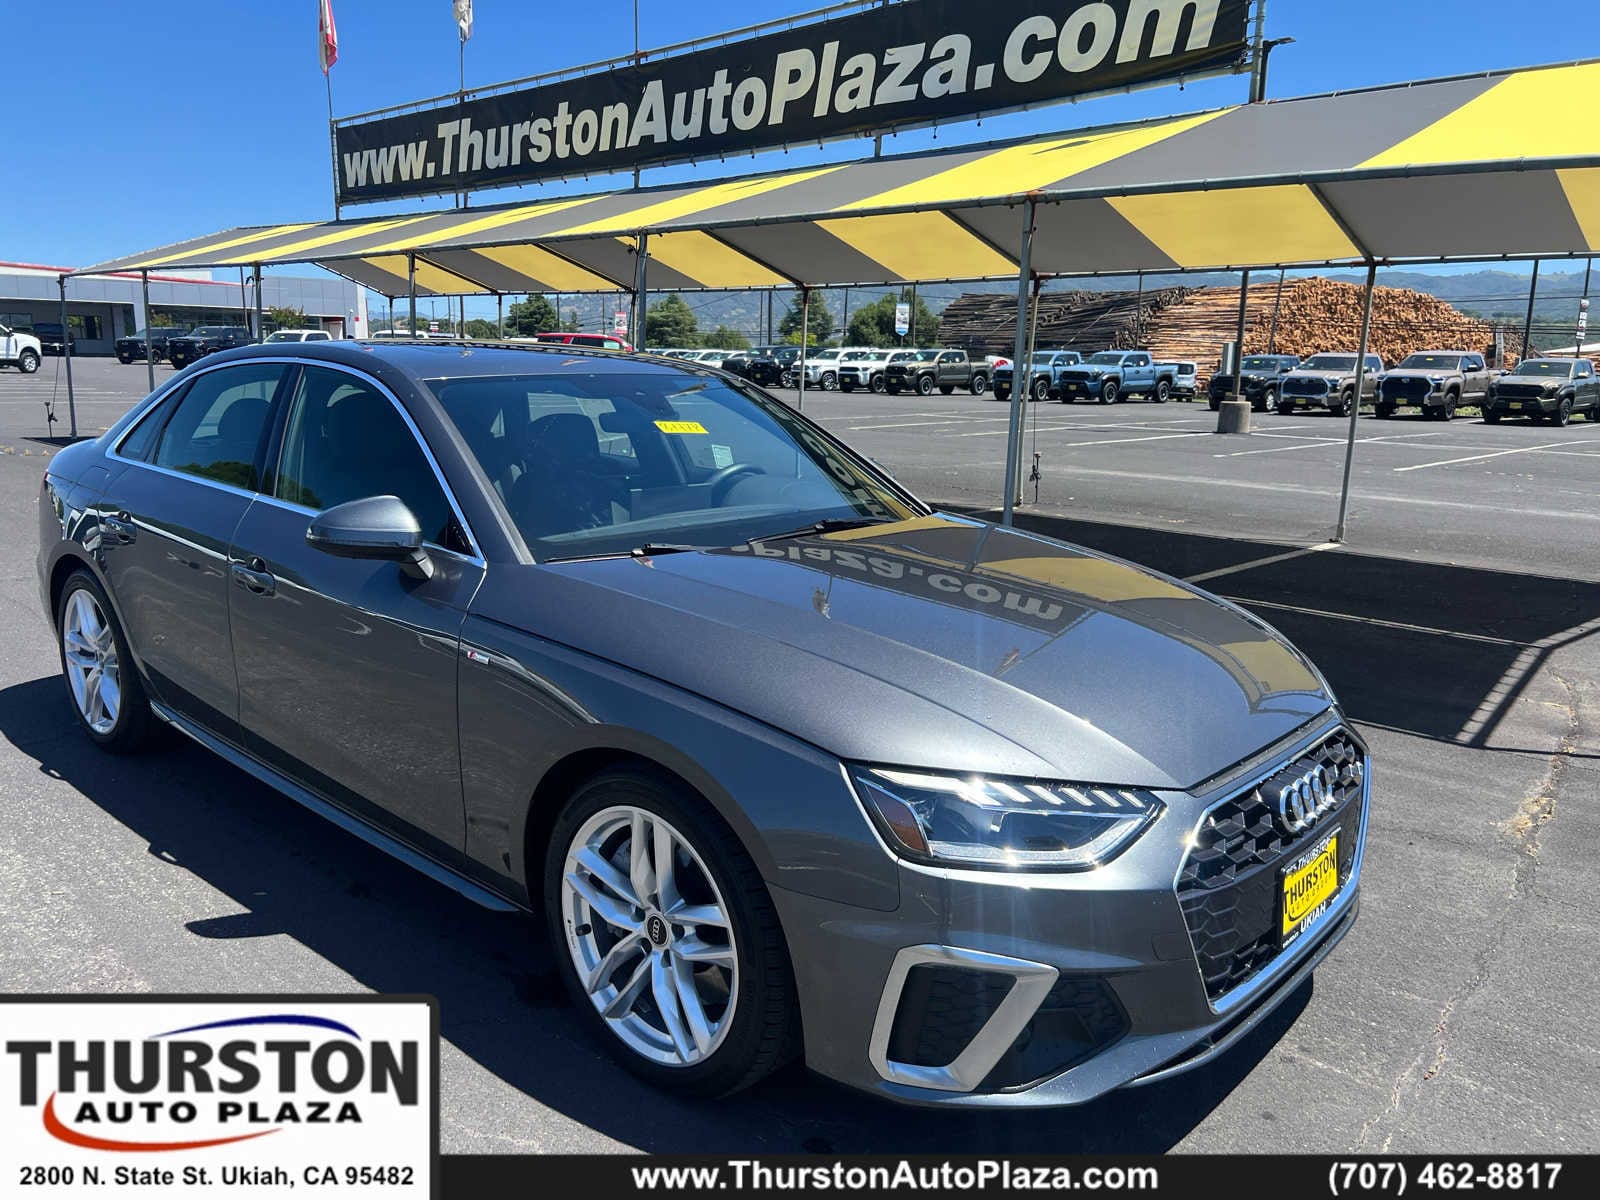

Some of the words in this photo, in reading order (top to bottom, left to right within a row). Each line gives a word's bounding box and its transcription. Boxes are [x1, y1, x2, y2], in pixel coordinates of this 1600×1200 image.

[343, 0, 1220, 188] www.ThurstonAutoPlaza.com
[1284, 848, 1336, 915] THURSTON
[1300, 901, 1326, 934] UKIAH
